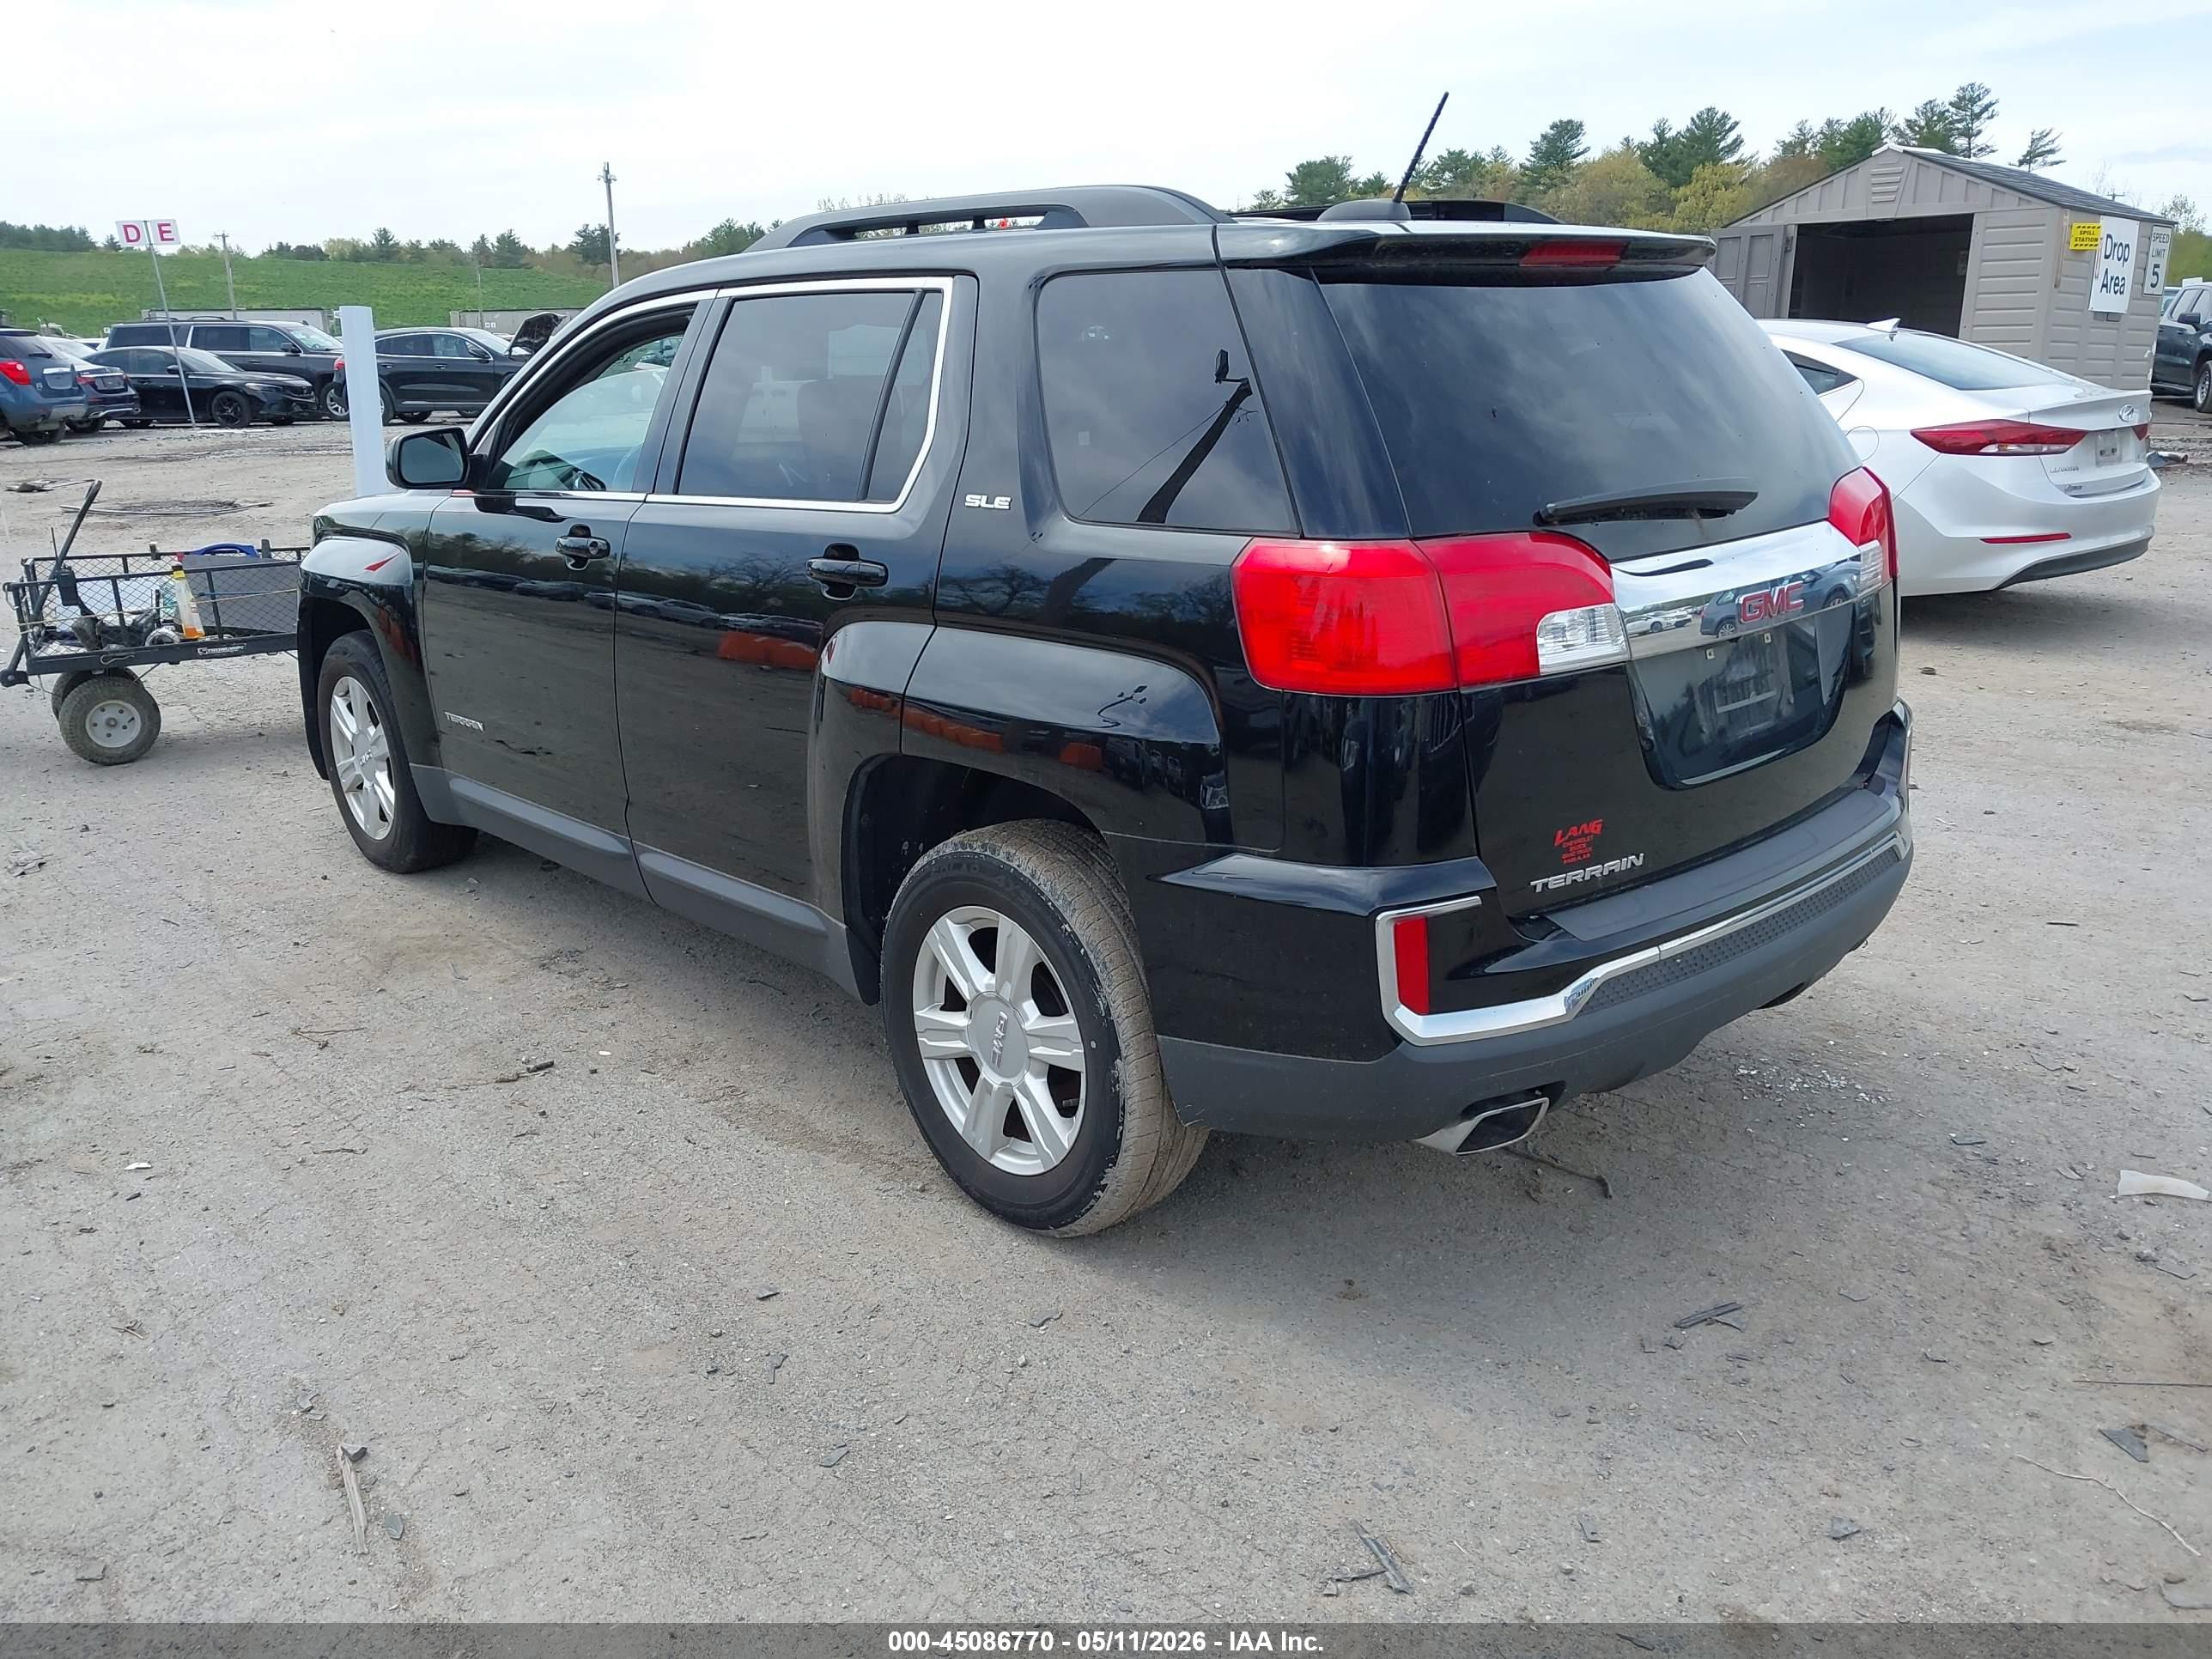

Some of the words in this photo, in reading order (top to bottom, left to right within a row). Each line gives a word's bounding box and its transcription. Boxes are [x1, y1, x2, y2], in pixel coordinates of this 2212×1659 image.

[123, 224, 141, 243] D
[157, 222, 175, 242] E
[2152, 232, 2170, 244] SPEED
[2104, 233, 2130, 268] Drop
[2152, 247, 2166, 258] LIMIT
[2100, 267, 2126, 296] Area
[2149, 263, 2160, 289] 5
[964, 494, 1012, 510] SLE
[1735, 580, 1804, 623] GMC
[1529, 853, 1644, 893] TERRAIN
[991, 1011, 1008, 1070] GMC
